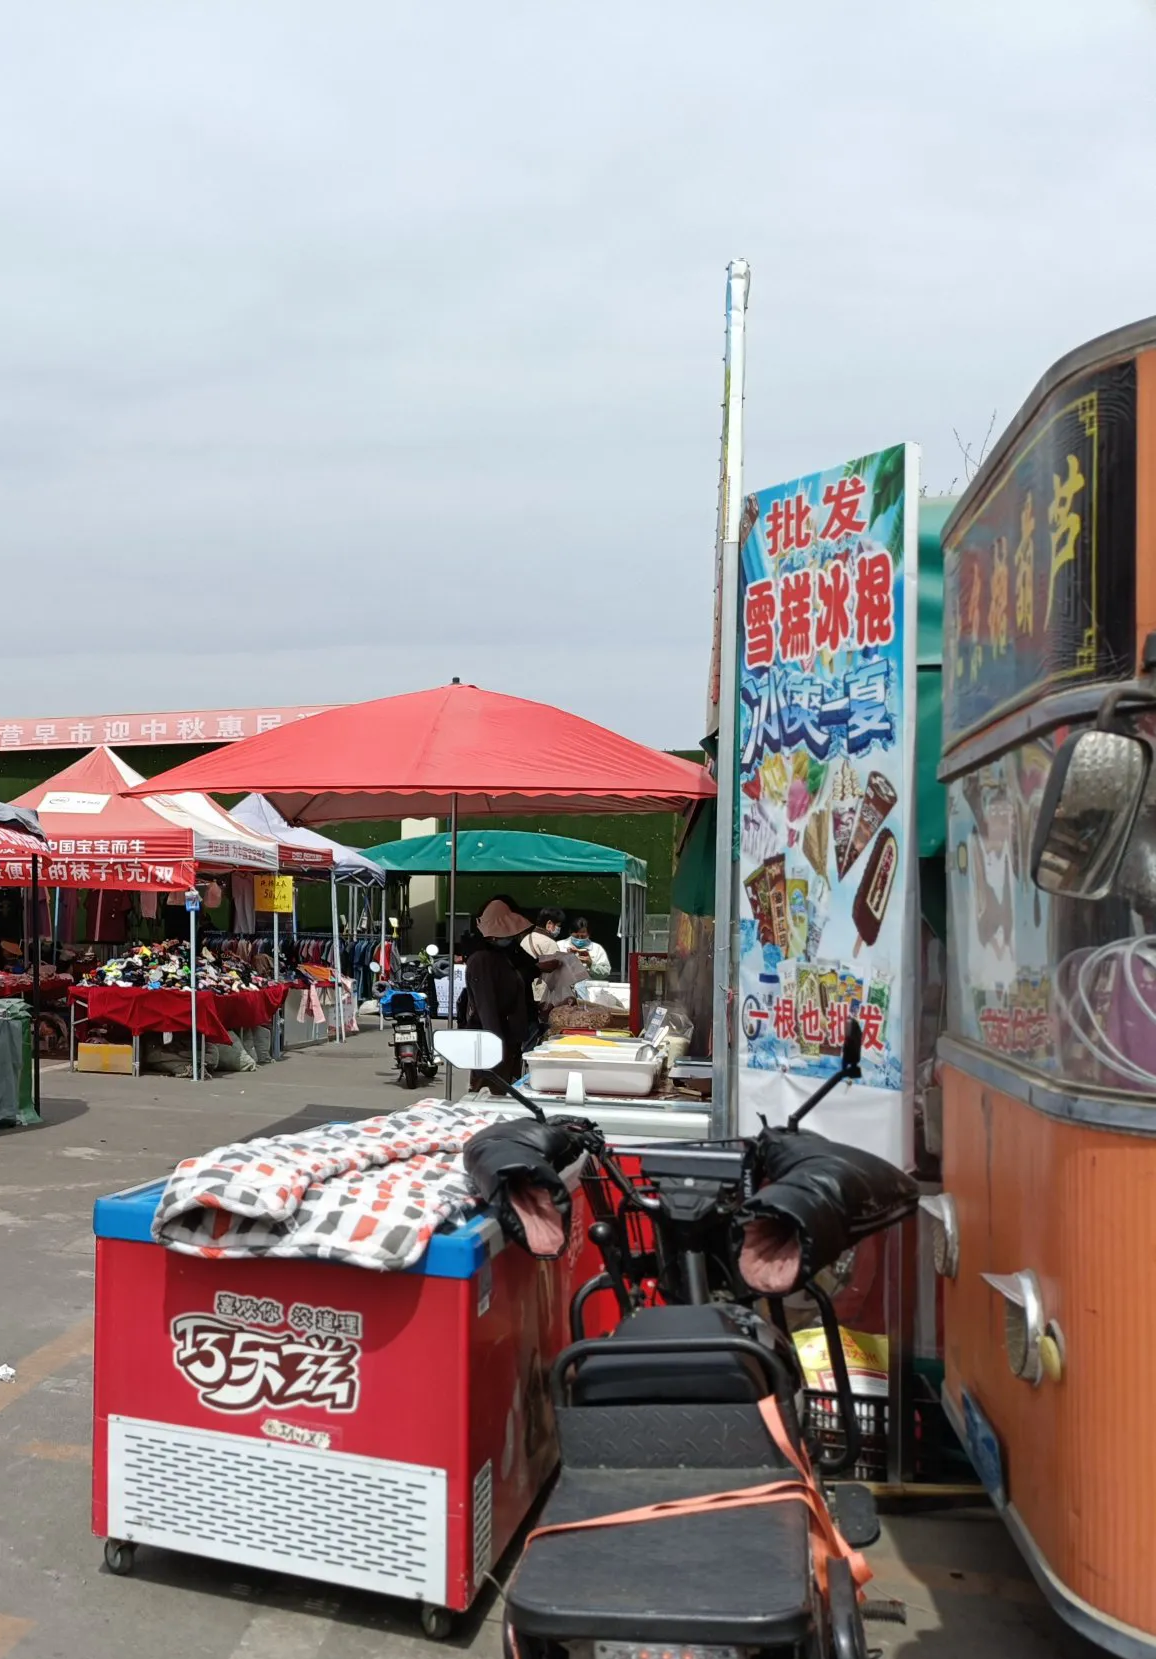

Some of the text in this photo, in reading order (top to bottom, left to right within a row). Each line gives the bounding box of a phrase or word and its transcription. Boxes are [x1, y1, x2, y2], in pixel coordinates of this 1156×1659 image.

[765, 476, 868, 558] 批发
[744, 552, 892, 668] 雪糕冰棍
[741, 658, 891, 764] 冰爽一夏
[748, 998, 885, 1051] 一根也批发
[217, 1293, 361, 1336] 喜欢你 没道理
[174, 1317, 357, 1411] 巧乐兹
